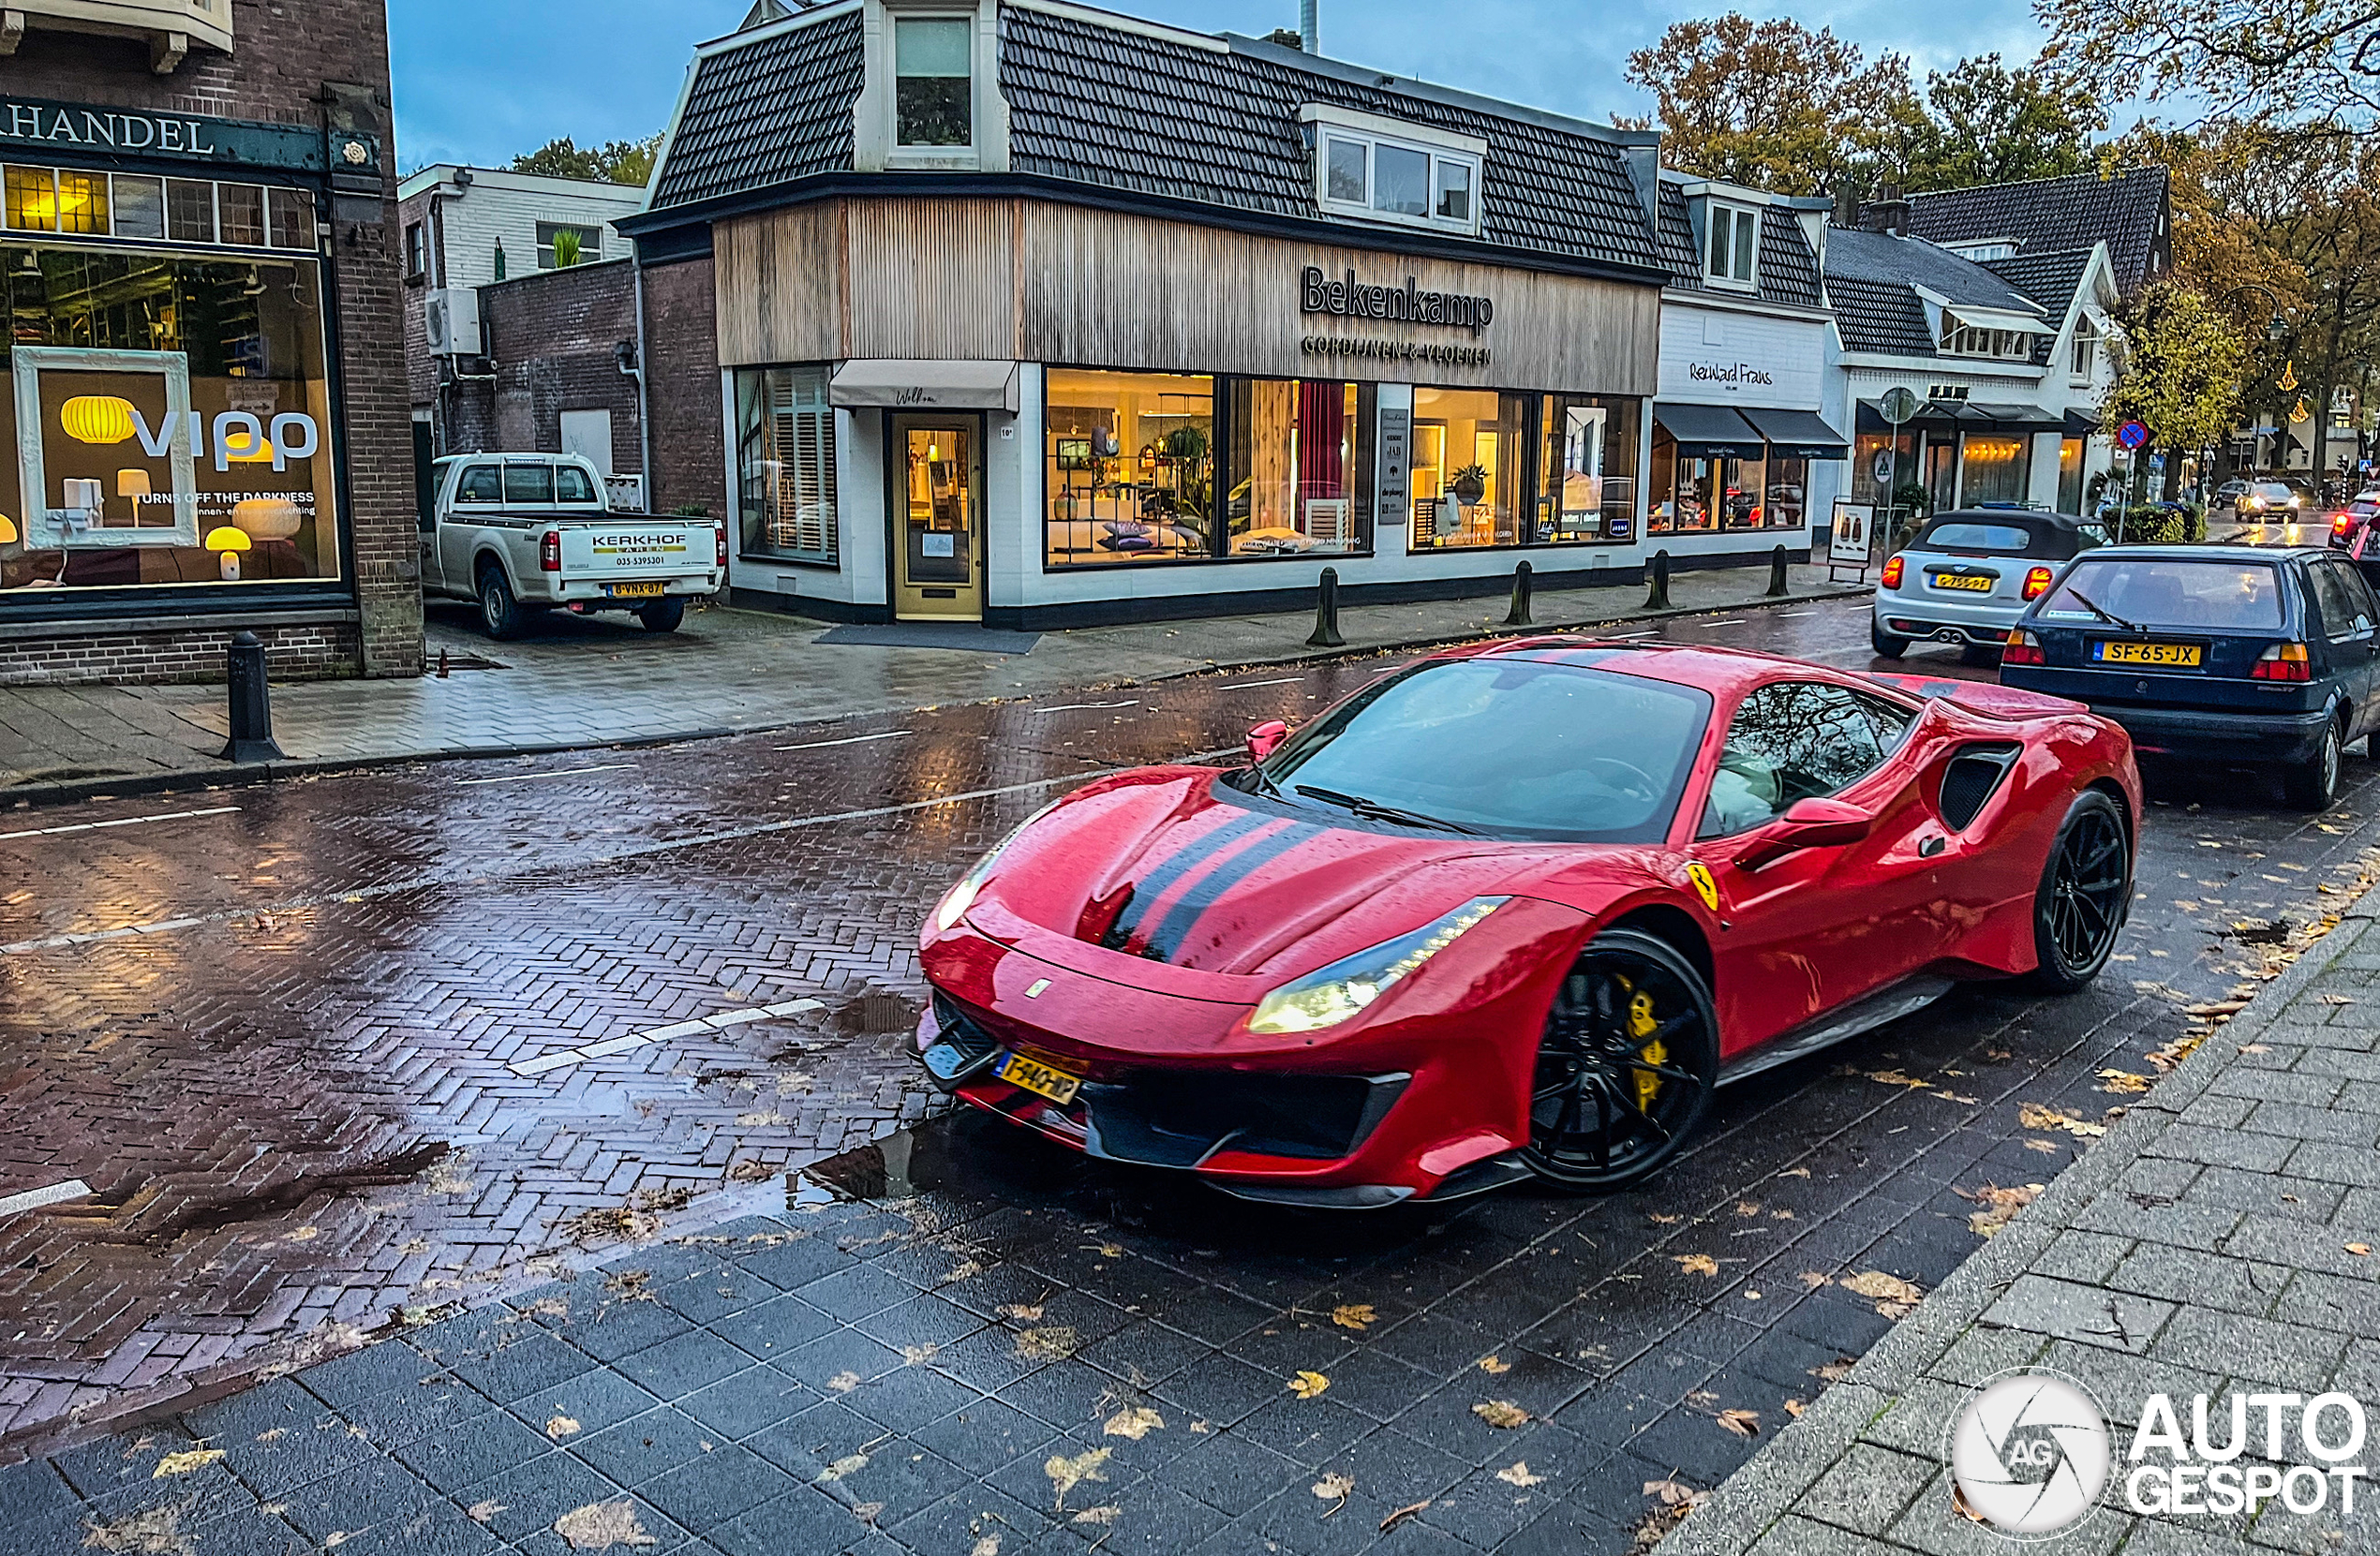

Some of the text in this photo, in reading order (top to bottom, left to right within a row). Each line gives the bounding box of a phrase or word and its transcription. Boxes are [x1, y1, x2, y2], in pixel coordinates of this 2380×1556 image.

[0, 103, 215, 155] HANDEL
[1303, 264, 1494, 336] Bekenkamp
[1303, 335, 1492, 365] GORDIJNEN & VLOEREN
[128, 410, 319, 472] vipp
[136, 492, 315, 504] TURNS OFF THE DARKNESS
[592, 535, 686, 546] KERKHOF
[617, 556, 664, 566] 035-5395301
[2111, 645, 2194, 663] SF-65-JX
